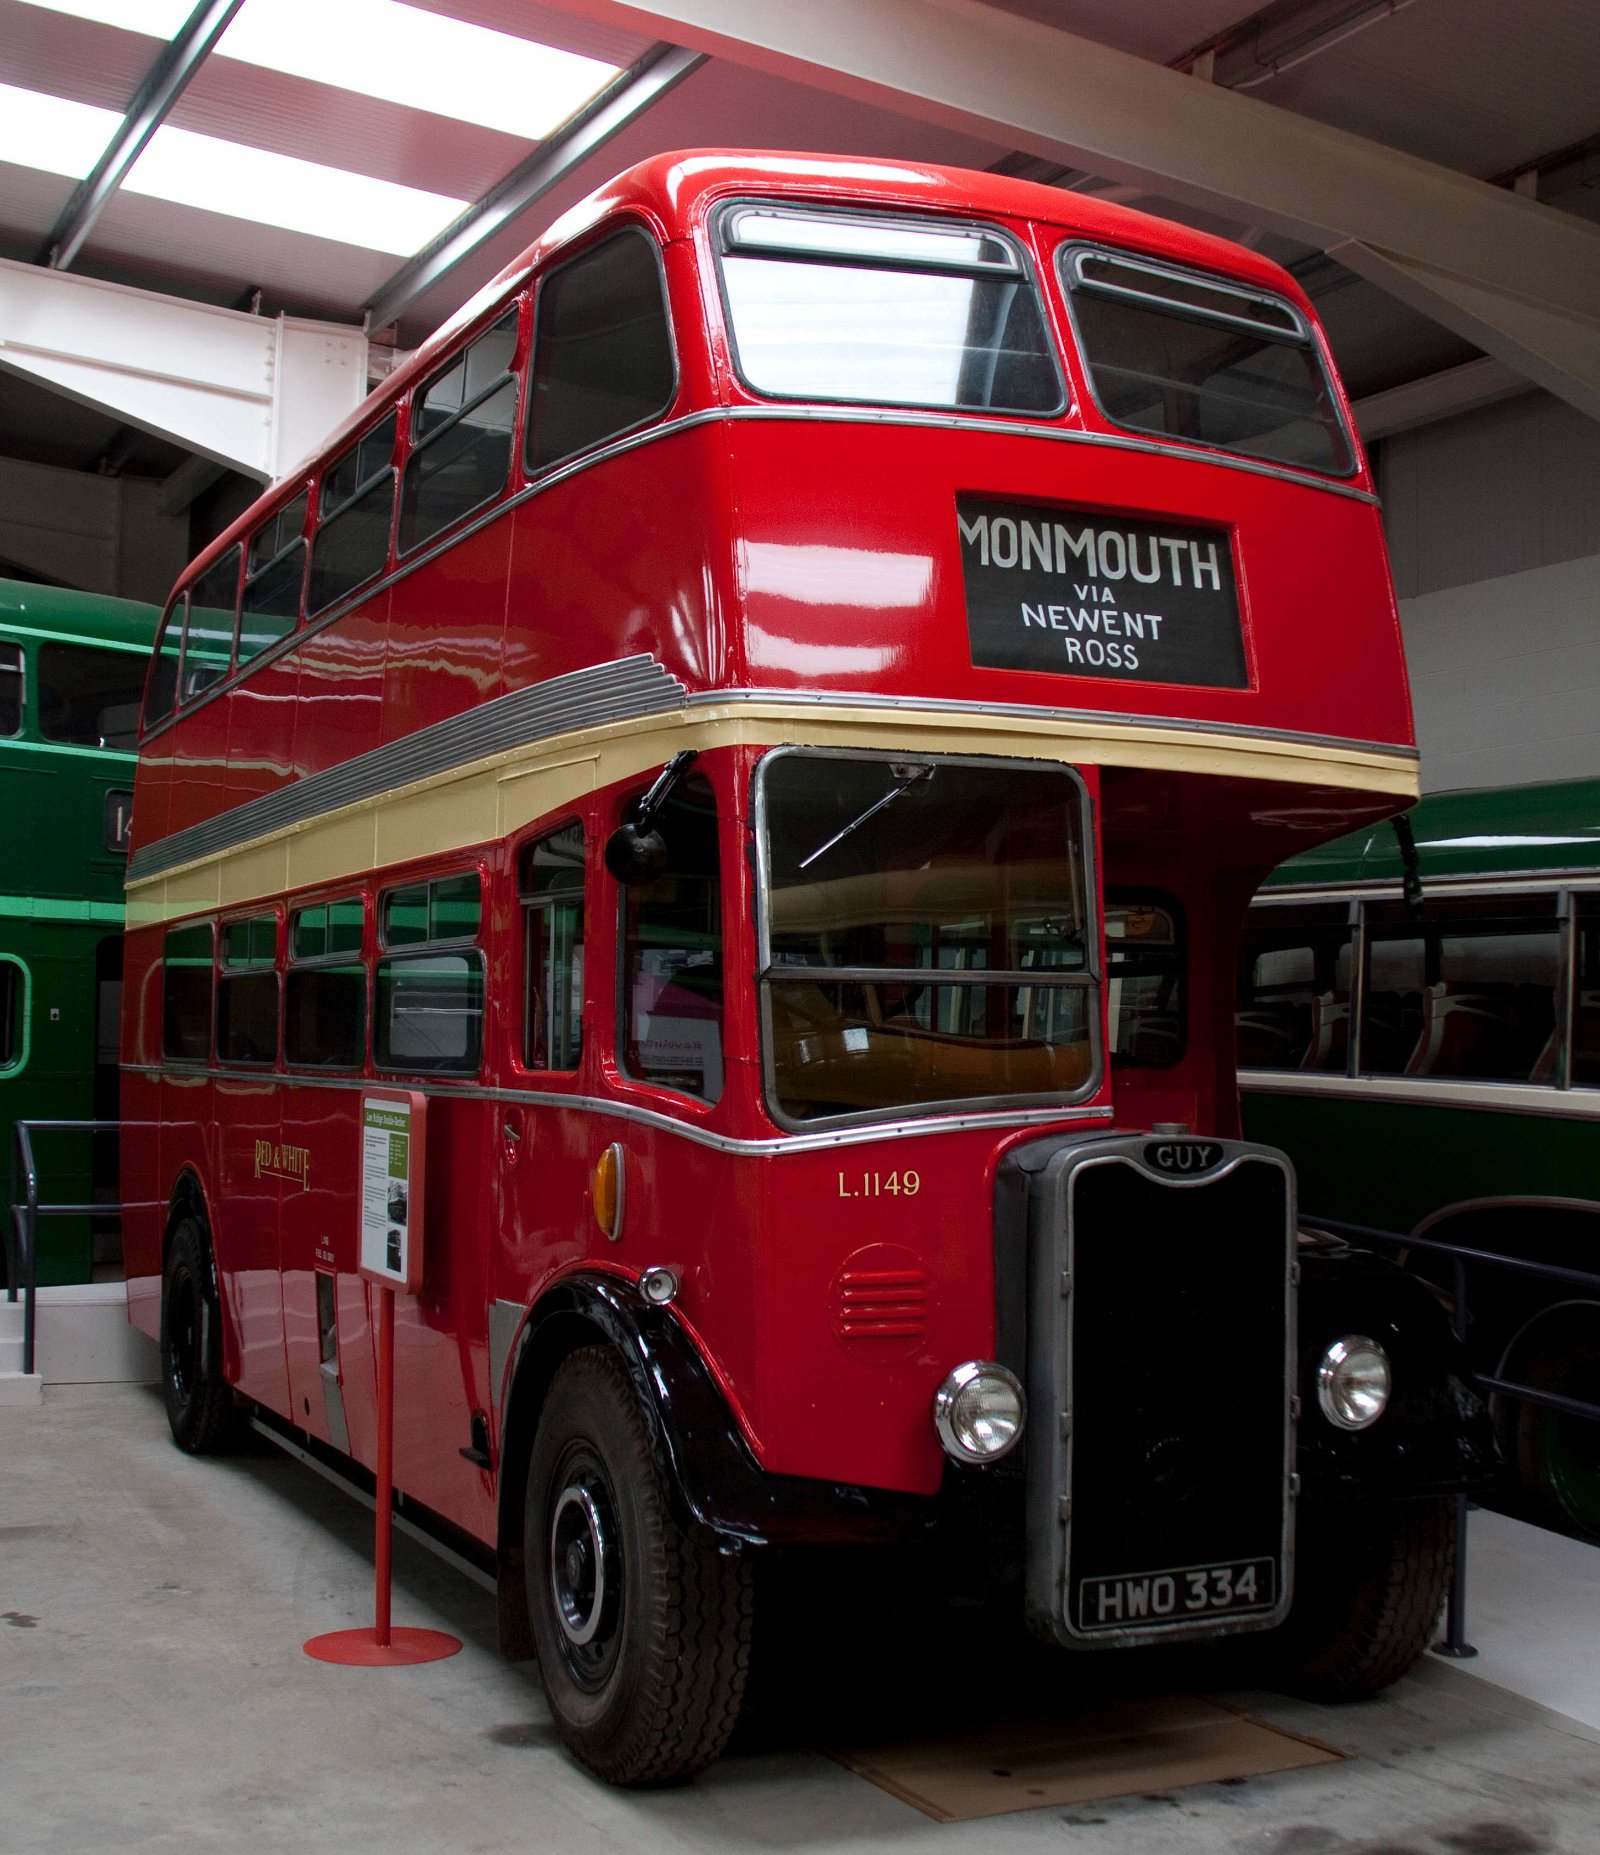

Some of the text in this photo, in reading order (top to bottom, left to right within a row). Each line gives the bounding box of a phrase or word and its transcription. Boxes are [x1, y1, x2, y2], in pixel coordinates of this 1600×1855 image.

[957, 513, 1220, 590] MONMOUTH
[1074, 584, 1116, 604] VIA
[1021, 602, 1162, 640] NEWENT
[1065, 637, 1139, 670] ROSS
[254, 1139, 310, 1192] RED & WHITE
[1156, 1145, 1212, 1170] GUY
[838, 1170, 920, 1198] L.1149
[1098, 1566, 1257, 1622] HWO 334
